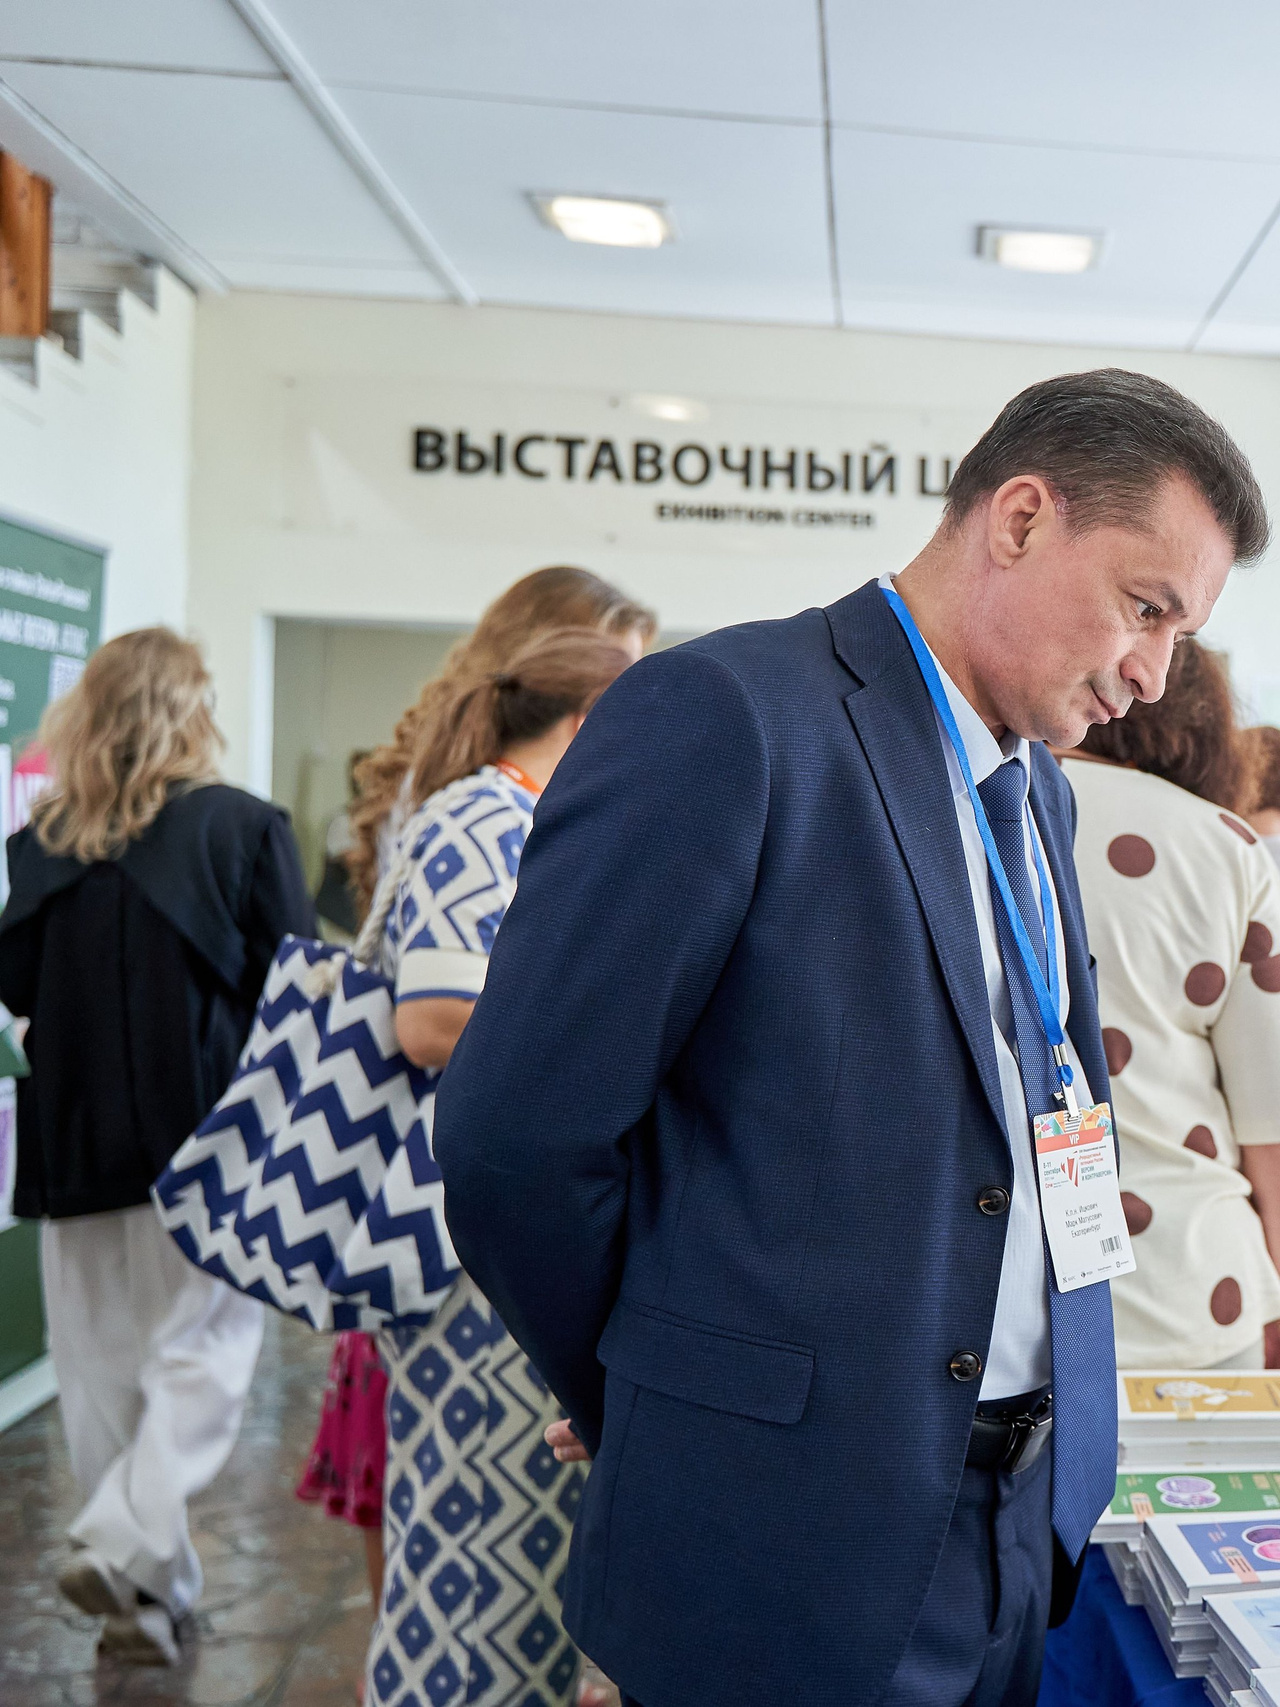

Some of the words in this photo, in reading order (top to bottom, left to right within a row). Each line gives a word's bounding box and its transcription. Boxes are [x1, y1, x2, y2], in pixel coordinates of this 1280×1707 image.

[412, 427, 898, 496] ВЫСТАВОЧНЫЙ
[656, 503, 786, 525] EXHIBITION
[792, 508, 875, 529] CENTER
[1068, 1133, 1080, 1145] VIP
[1064, 1219, 1078, 1228] Марк
[1070, 1223, 1102, 1238] Екатеринбург
